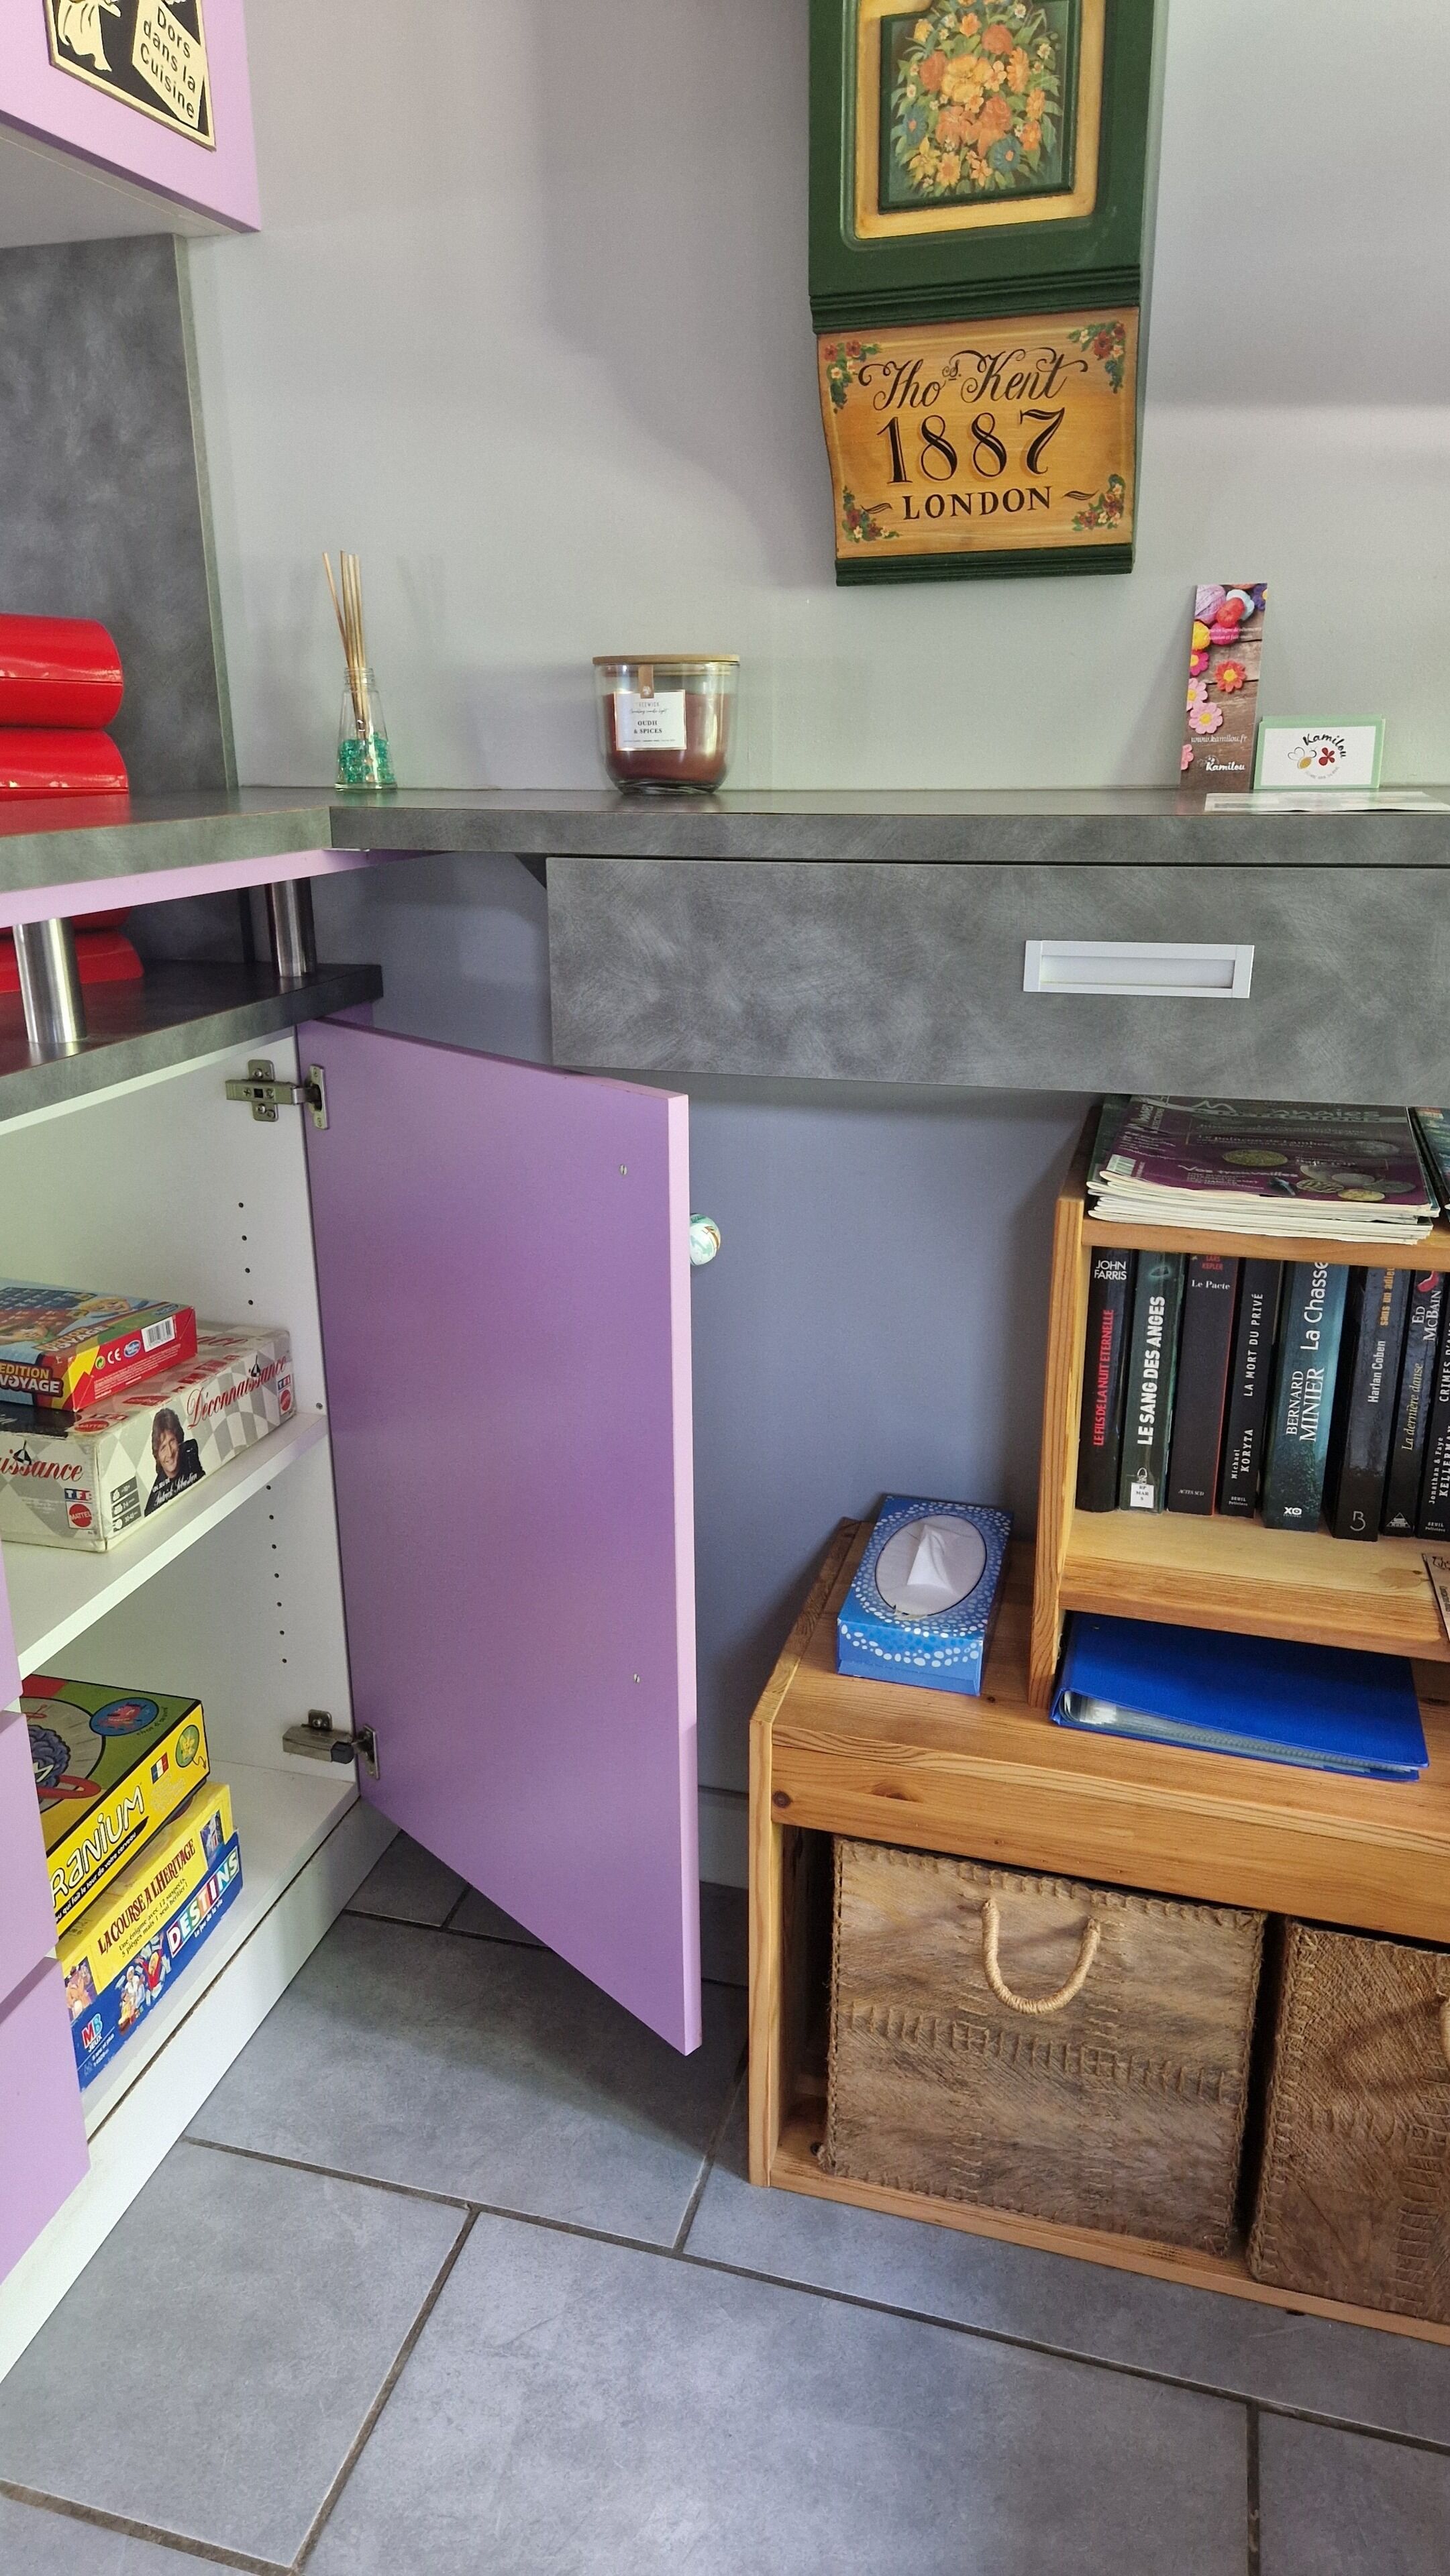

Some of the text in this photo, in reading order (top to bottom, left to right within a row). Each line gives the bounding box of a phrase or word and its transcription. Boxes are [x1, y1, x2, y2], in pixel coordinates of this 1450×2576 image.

[143, 20, 196, 93] dans la
[157, 6, 191, 59] Dors
[140, 42, 195, 119] Cuisine
[961, 347, 1088, 403] Kent
[876, 407, 1066, 484] 1887
[902, 486, 1053, 521] LONDON
[1191, 734, 1247, 743] www.kamilou.fr
[1302, 733, 1347, 759] Kamilou
[1206, 761, 1245, 771] Kamilou
[1094, 1269, 1127, 1281] FARRIS
[1096, 1259, 1127, 1271] JOHN
[1192, 1279, 1231, 1291] Le Pacte
[1300, 1262, 1329, 1351] La Chasse
[1380, 1306, 1391, 1326] sans
[1383, 1292, 1392, 1303] un
[0, 1364, 50, 1379] EDITION
[1137, 1295, 1165, 1446] LE SANG DES ANGES
[1243, 1293, 1264, 1397] LA MORT DU PRIVÉ
[1367, 1340, 1386, 1403] Harlan Coben
[0, 1374, 60, 1394] VOYAGE
[1093, 1309, 1114, 1446] LE FILS DE LA NUIT ETERNELLE
[1286, 1371, 1304, 1436] BERNARD
[1299, 1367, 1325, 1442] MINIER
[1402, 1362, 1423, 1451] La dernière danse
[1231, 1449, 1241, 1480] Michael
[1241, 1428, 1253, 1472] KORYTA
[1429, 1466, 1440, 1505] Jonathan
[1435, 1436, 1444, 1455] Faye
[69, 1512, 93, 1521] MATTEL
[1284, 1507, 1302, 1515] XO
[62, 1902, 72, 1915] qui
[87, 1876, 97, 1890] tour
[97, 1868, 105, 1878] de
[105, 1855, 117, 1869] votre
[117, 1832, 136, 1856] cerveau
[97, 1931, 113, 1955] LA
[110, 1893, 147, 1943] COURSE
[143, 1885, 153, 1906] A
[119, 1878, 186, 1951] Une énigme avec 12 suspects
[126, 1933, 143, 1955] pièges
[142, 1921, 155, 1933] mais
[159, 1905, 170, 1918] seul
[169, 1886, 185, 1907] héritier
[168, 1849, 238, 1953] DESTINS
[205, 1912, 213, 1923] de
[82, 2013, 103, 2049] MB
[88, 2033, 103, 2053] JEUX
